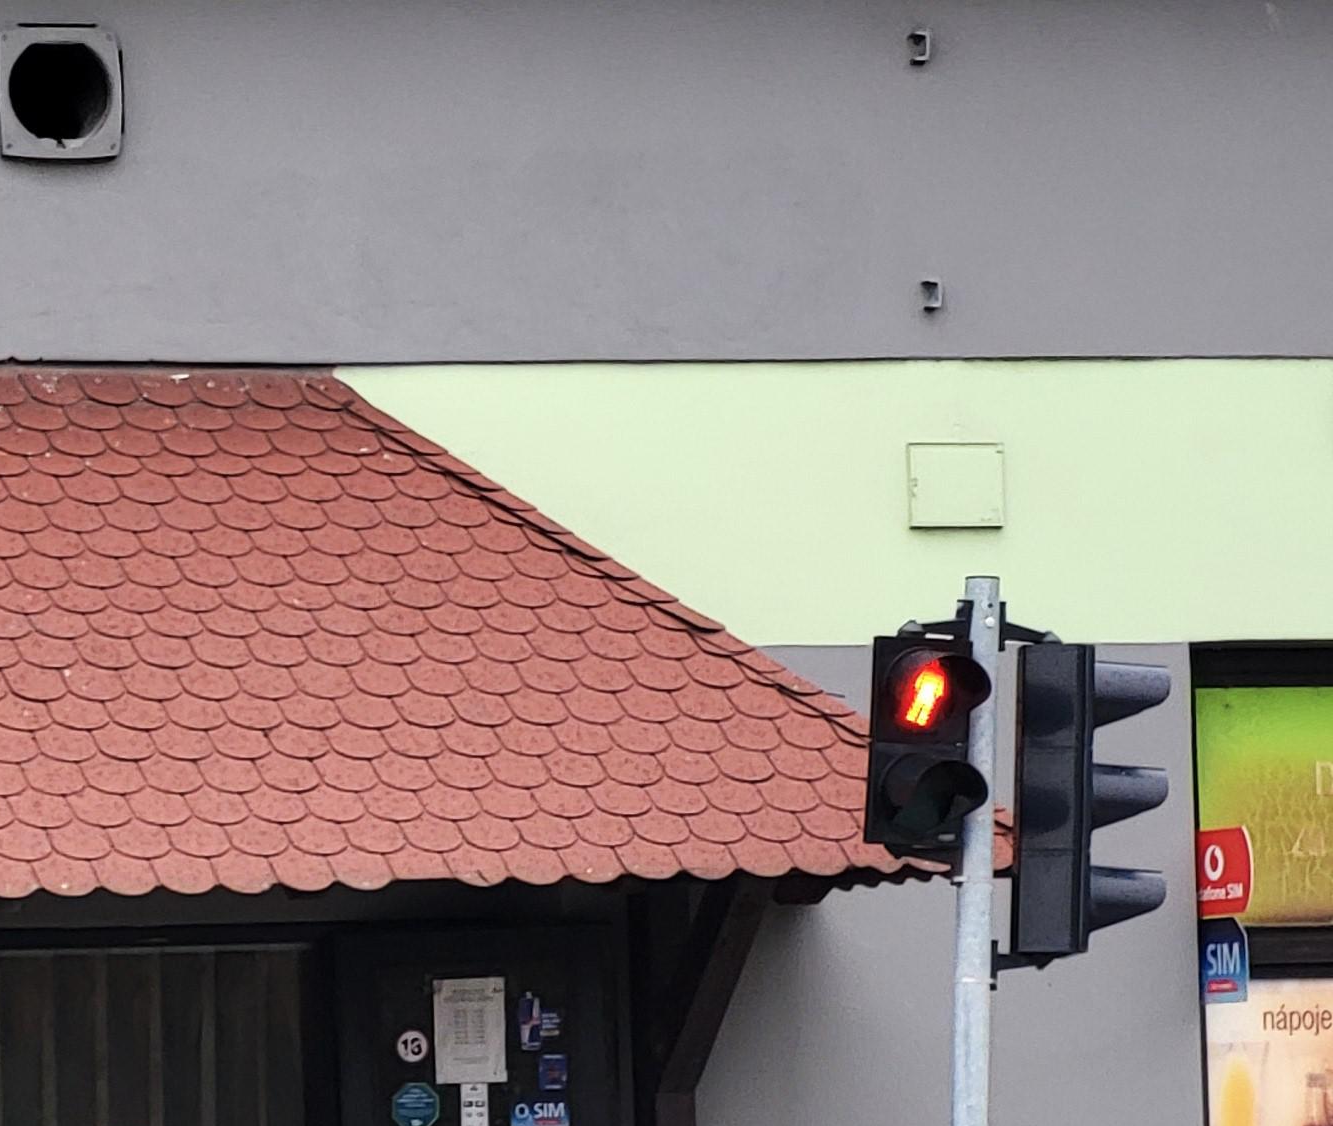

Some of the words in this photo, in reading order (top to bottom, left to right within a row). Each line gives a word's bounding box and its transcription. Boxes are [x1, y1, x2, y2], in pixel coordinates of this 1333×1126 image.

[1206, 943, 1240, 976] SIM
[1263, 1004, 1332, 1036] nápoje
[533, 1102, 565, 1119] SIM
